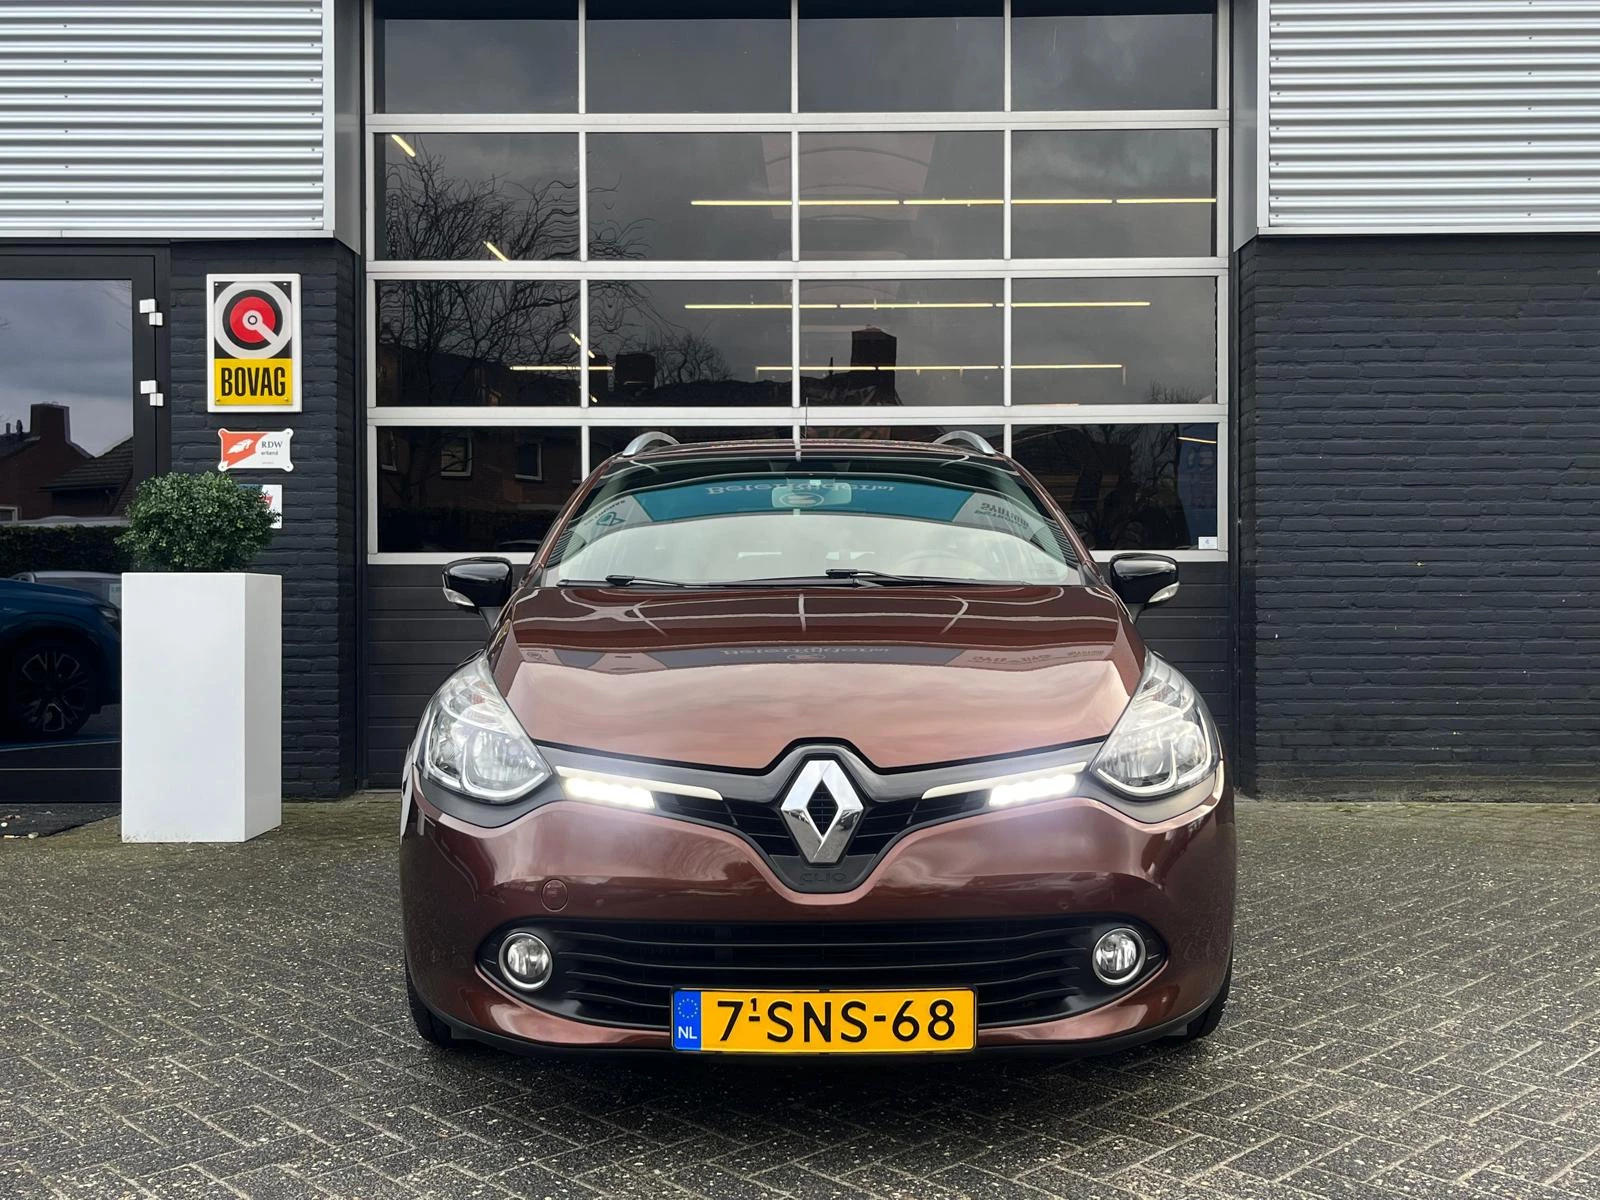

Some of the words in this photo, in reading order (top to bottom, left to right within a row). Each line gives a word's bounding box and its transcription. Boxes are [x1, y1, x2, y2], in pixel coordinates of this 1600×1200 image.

[221, 367, 286, 397] BOVAG
[261, 440, 283, 448] RDW
[801, 872, 847, 881] CLIO
[677, 1026, 697, 1039] NL
